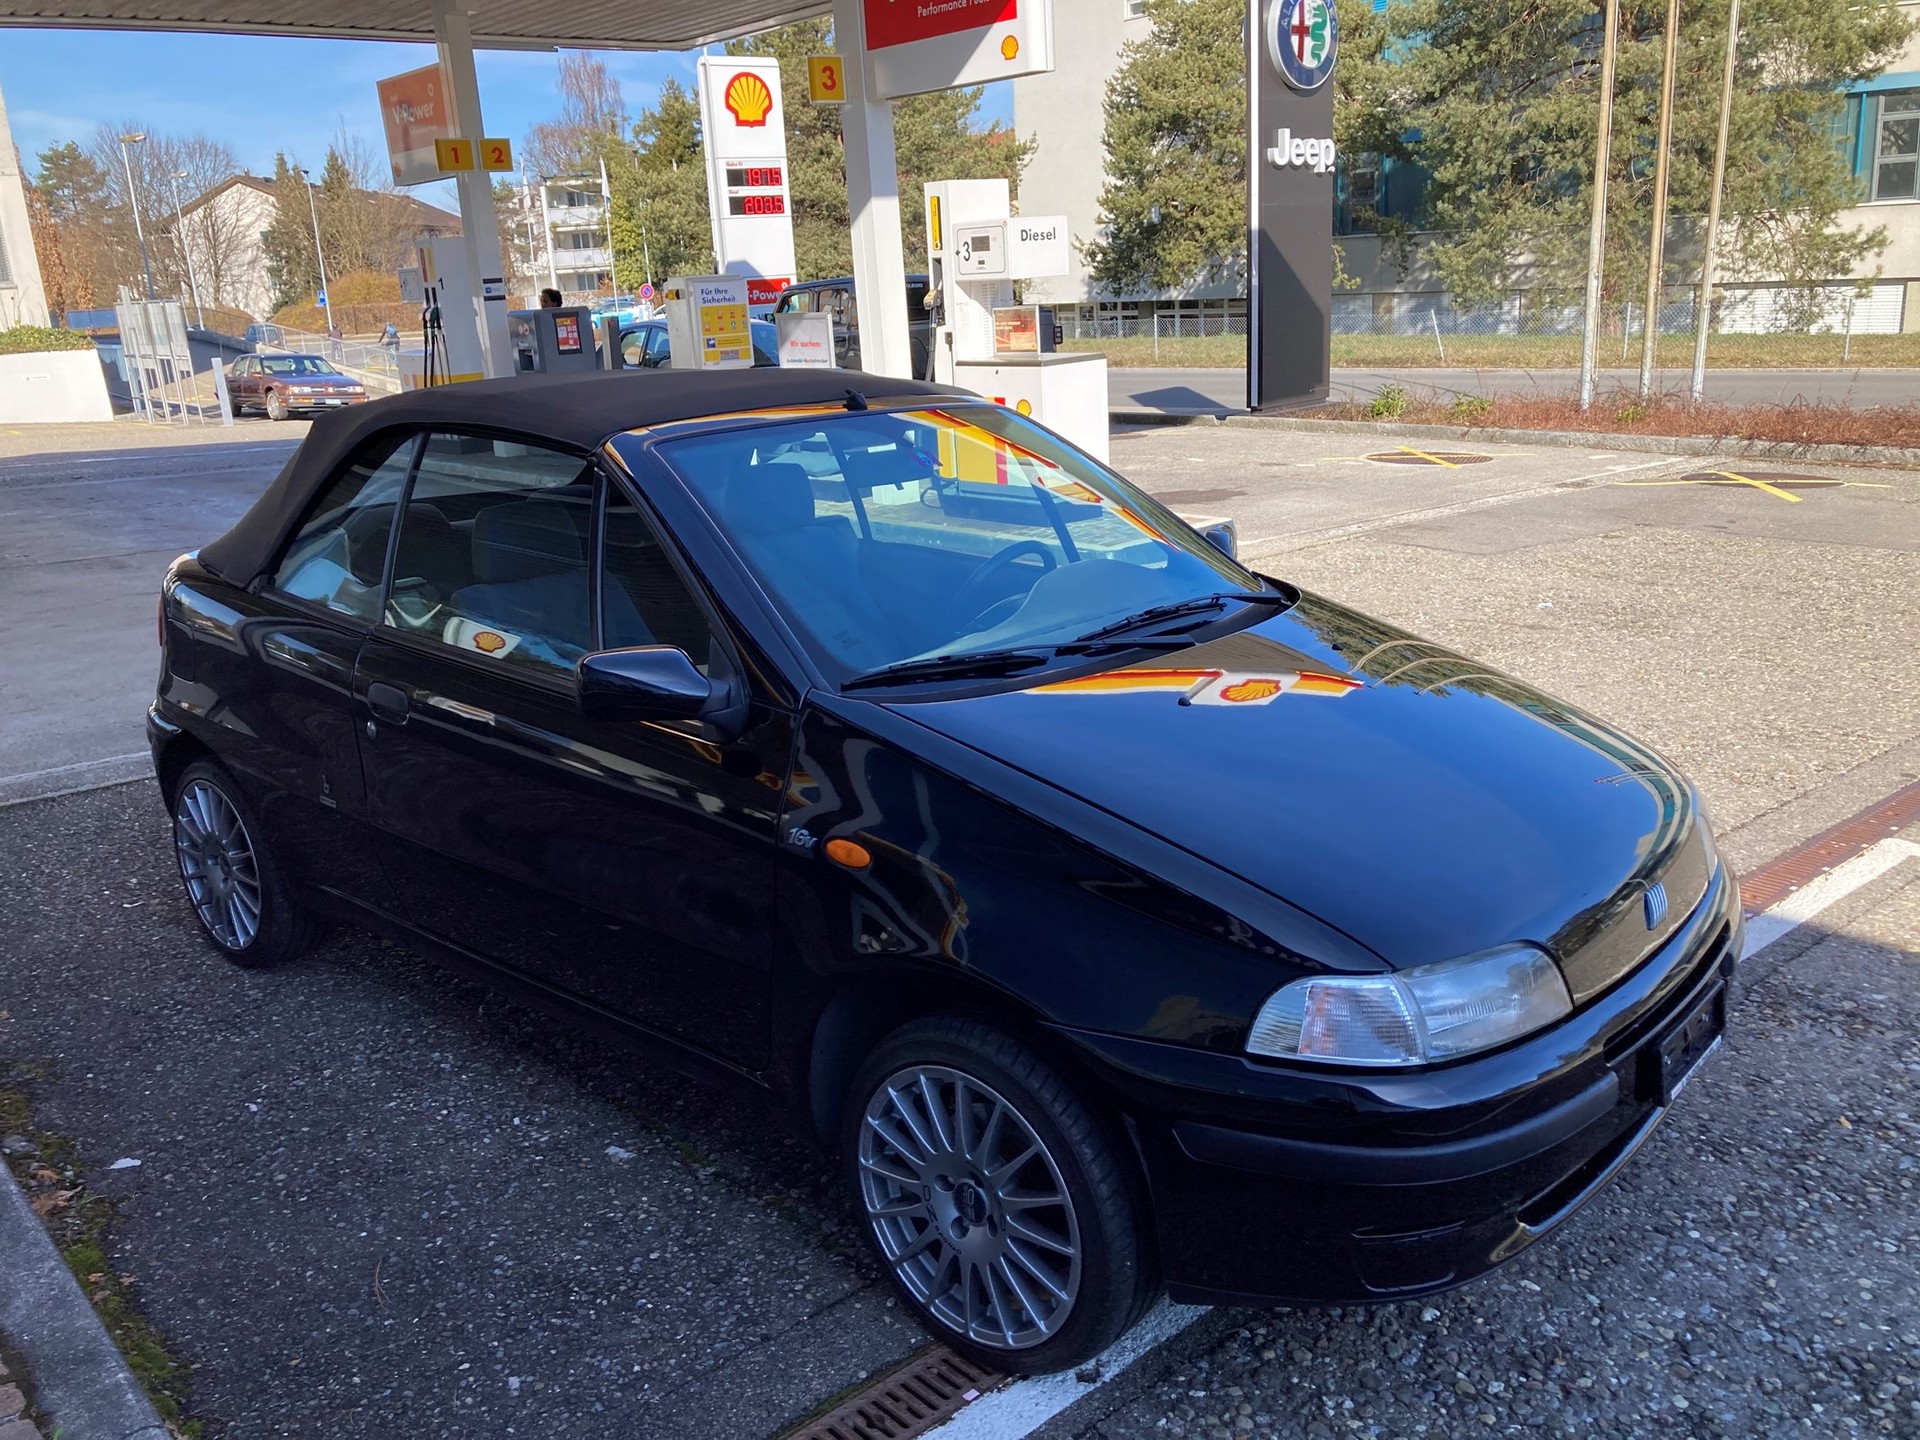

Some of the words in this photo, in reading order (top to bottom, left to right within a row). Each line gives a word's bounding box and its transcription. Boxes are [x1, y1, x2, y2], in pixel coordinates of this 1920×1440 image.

[917, 0, 967, 18] Performance
[821, 65, 837, 91] 3
[391, 102, 434, 126] V-Power
[451, 146, 460, 164] 1
[491, 146, 505, 164] 2
[1267, 128, 1335, 173] Jeep
[744, 196, 784, 214] 203.5
[1020, 227, 1056, 241] Diesel
[962, 240, 971, 262] 3
[701, 288, 712, 296] Für
[714, 287, 728, 295] Ihre
[702, 295, 736, 304] Sicherheit
